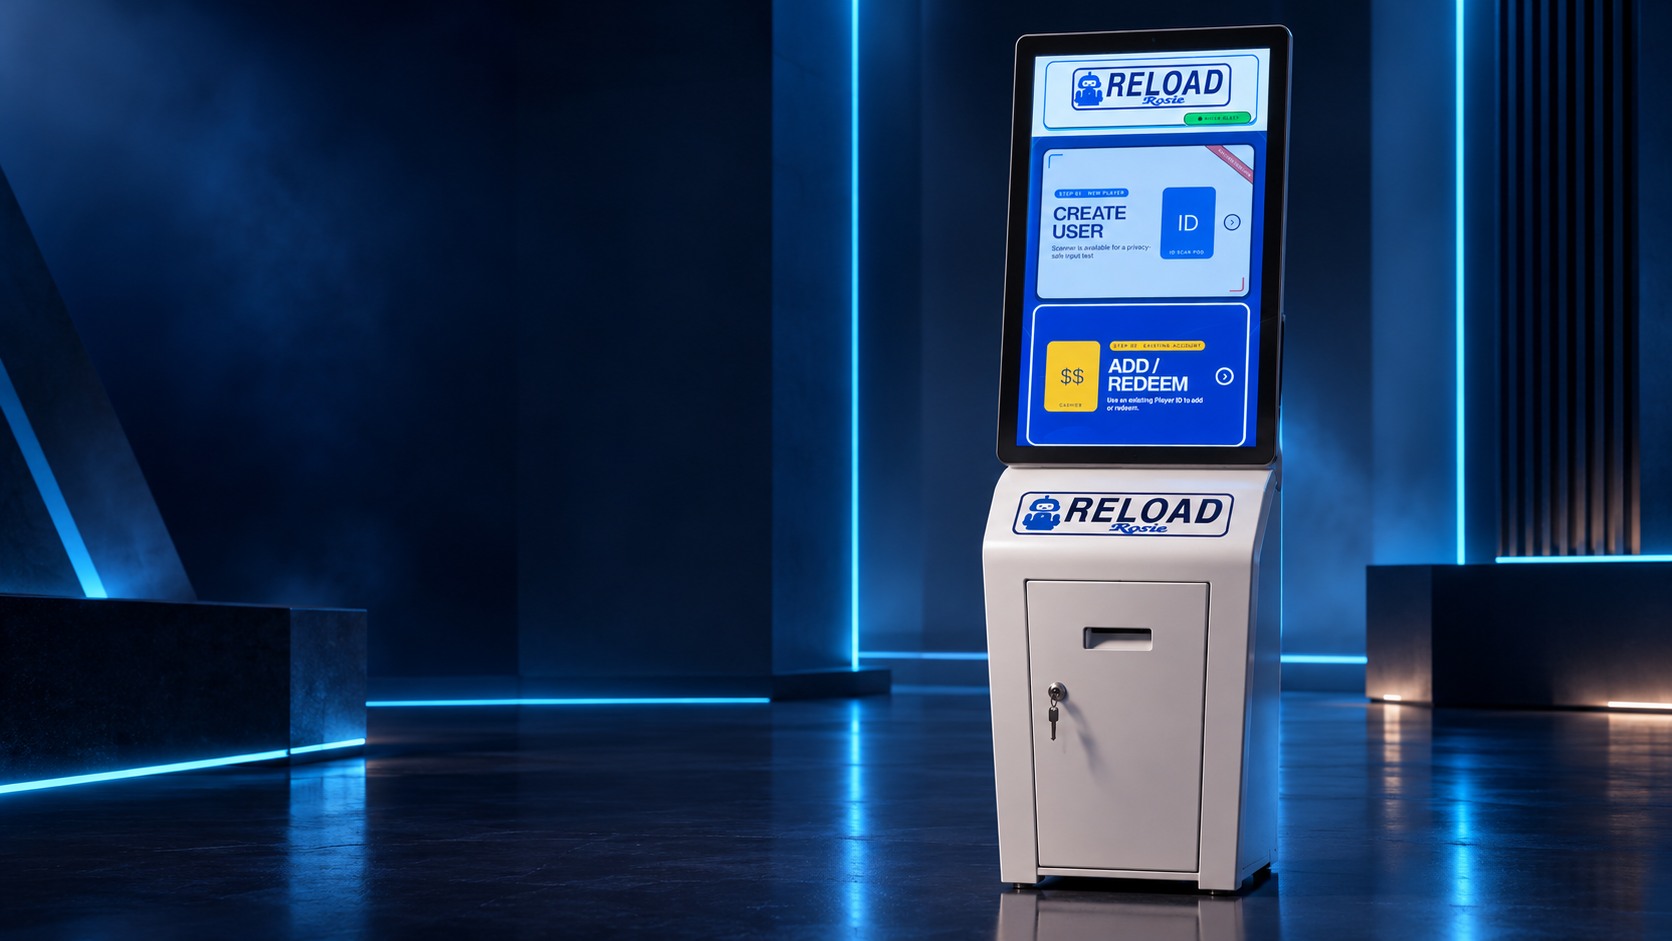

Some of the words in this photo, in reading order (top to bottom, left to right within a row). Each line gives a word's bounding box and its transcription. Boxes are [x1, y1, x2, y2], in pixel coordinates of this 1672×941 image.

[1106, 69, 1224, 97] RELOAD
[1142, 95, 1185, 106] Rosie
[1053, 206, 1126, 221] CREATE
[1178, 214, 1199, 232] ID
[1052, 224, 1104, 239] USER
[1108, 358, 1149, 374] ADD
[1152, 358, 1160, 374] /
[1060, 368, 1084, 386] $$
[1108, 376, 1188, 392] REDEEM
[1064, 497, 1223, 524] RELOAD
[1108, 523, 1169, 534] Rosie
